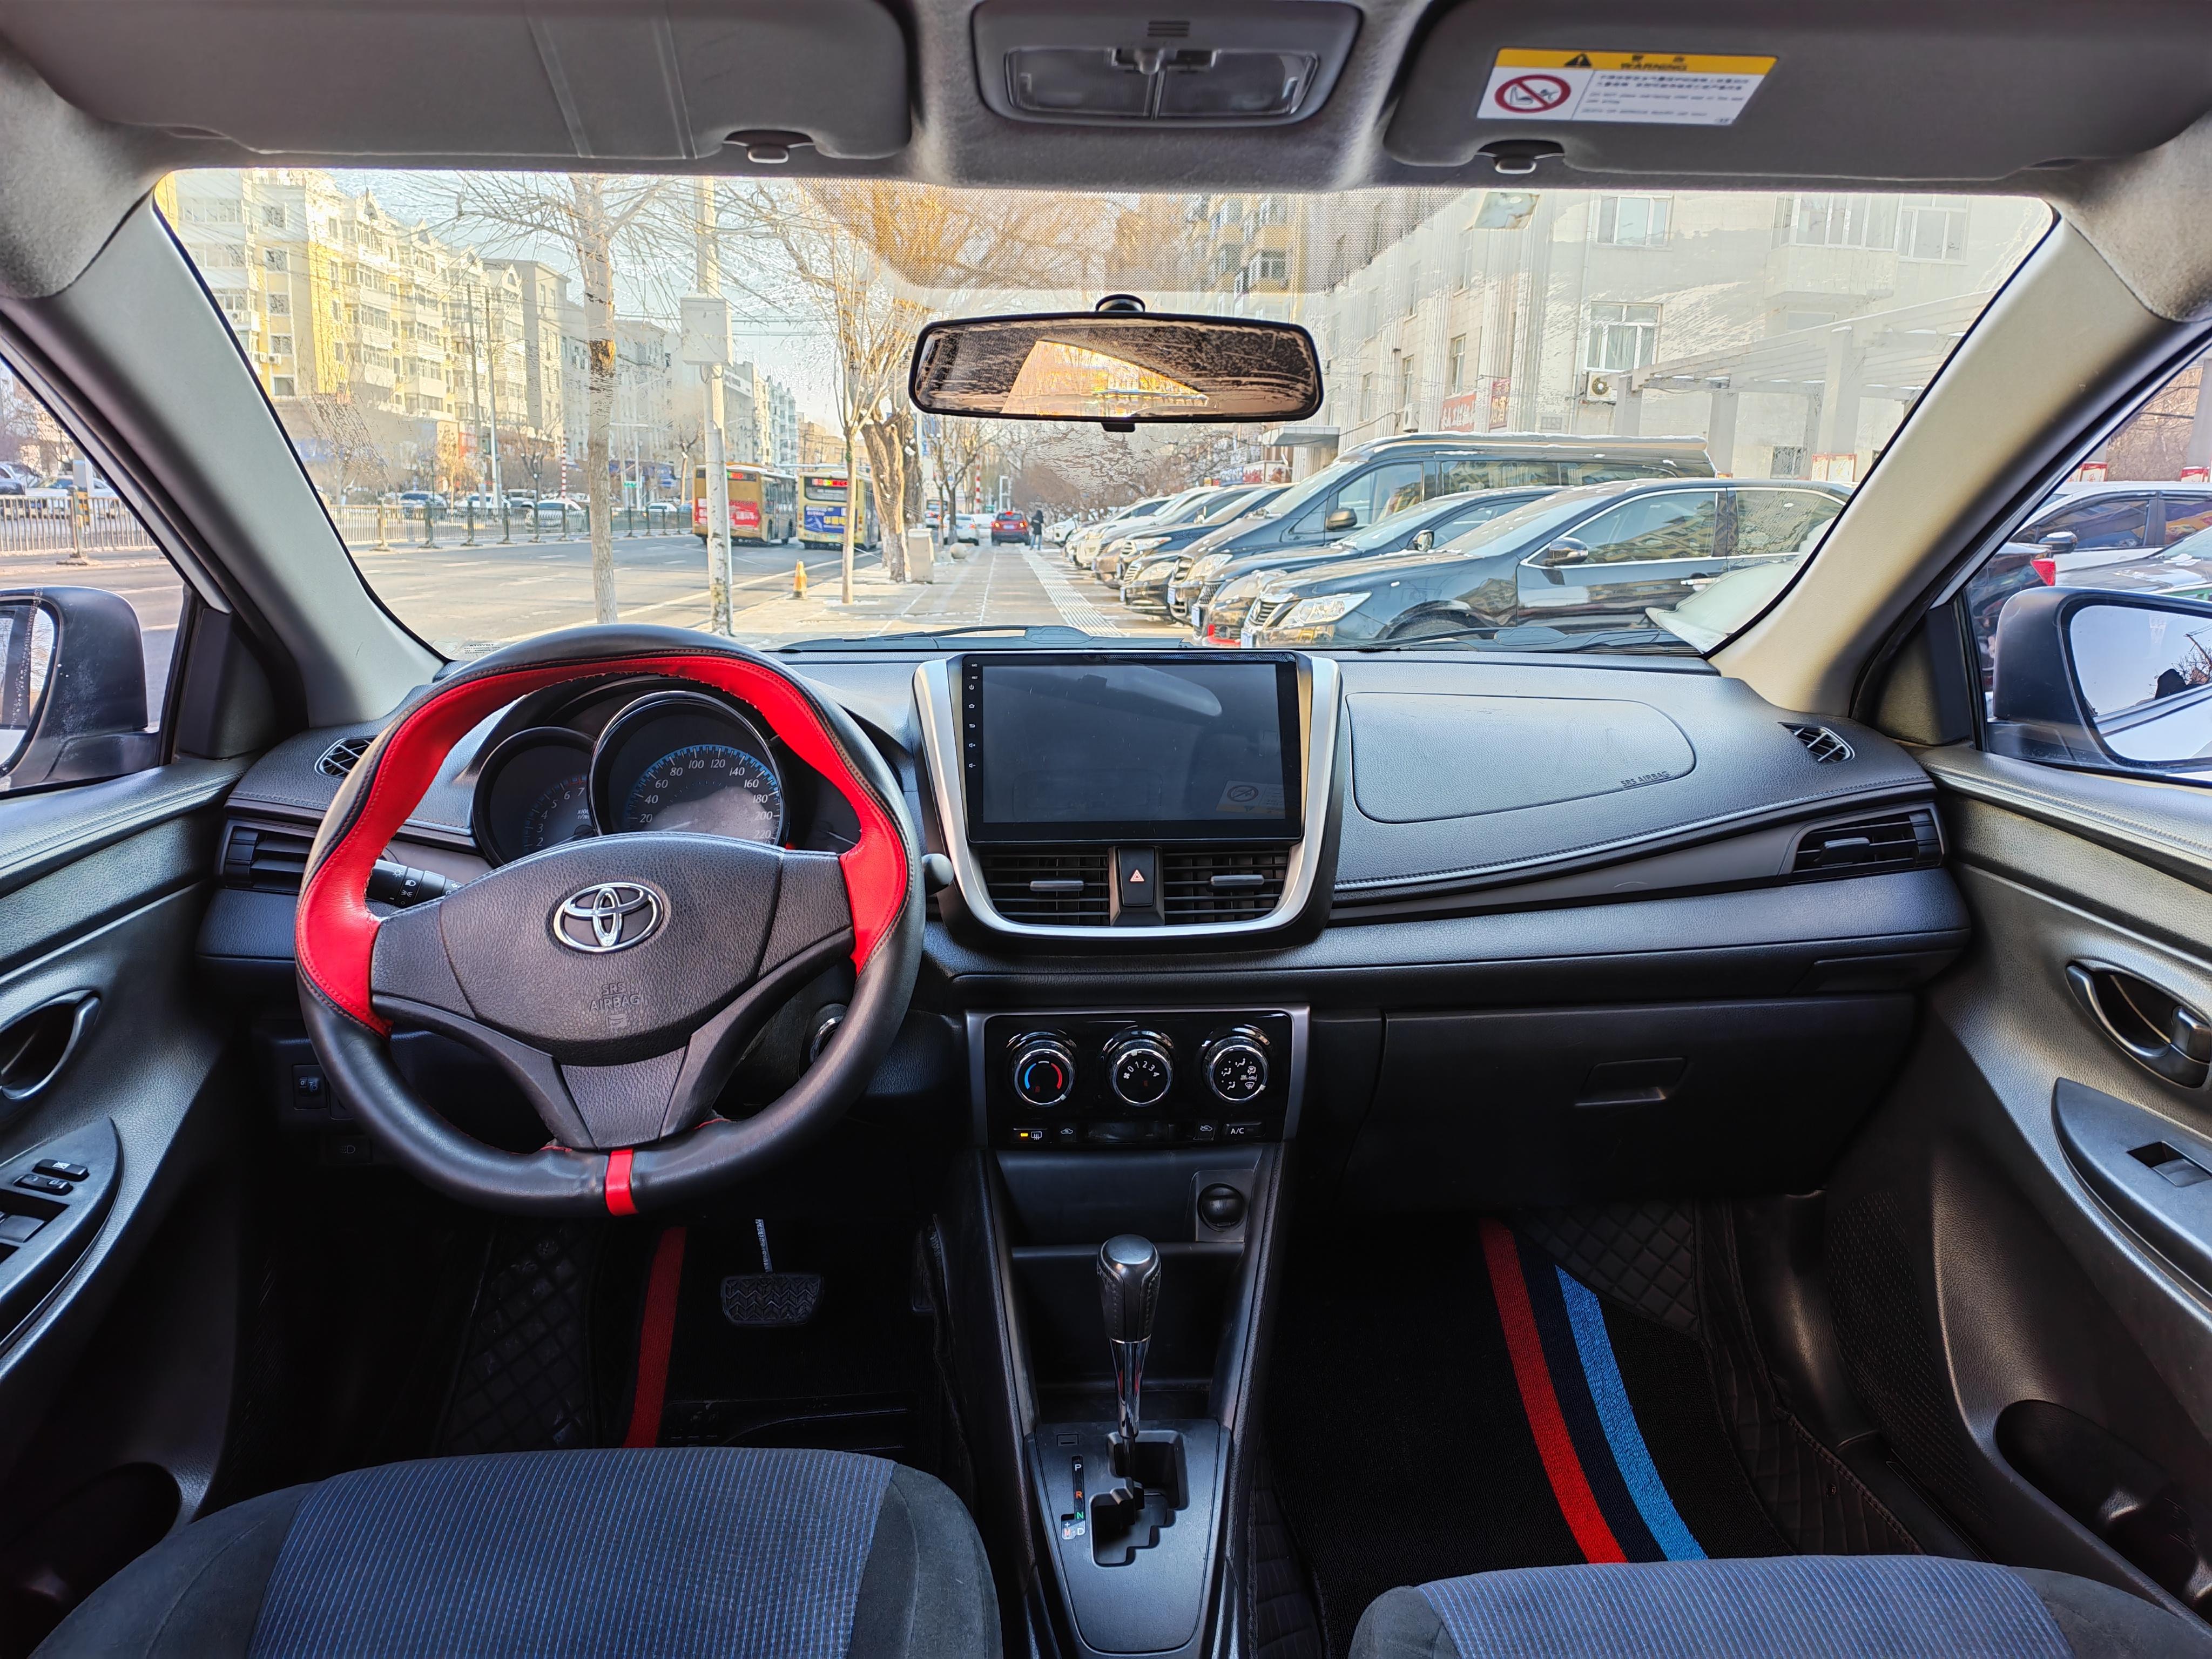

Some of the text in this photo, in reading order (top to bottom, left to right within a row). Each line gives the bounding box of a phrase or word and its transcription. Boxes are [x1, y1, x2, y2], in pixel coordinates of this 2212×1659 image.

[689, 760, 704, 769] 100
[711, 759, 725, 768] 120
[670, 767, 683, 776] 80
[729, 767, 745, 776] 140
[655, 779, 668, 788] 60
[744, 779, 759, 788] 160
[1621, 771, 1670, 787] SRS AIRBAG
[564, 791, 571, 800] 6
[577, 787, 585, 797] 7
[644, 794, 658, 804] 40
[753, 794, 768, 803] 180
[551, 799, 558, 808] 5
[541, 810, 548, 819] 4
[639, 814, 653, 823] 20
[755, 811, 773, 820] 200
[537, 824, 544, 833] 3
[753, 830, 771, 839] 220
[536, 837, 543, 846] 2
[601, 982, 625, 995] SRS
[589, 994, 640, 1012] AIRBAG
[1063, 1528, 1071, 1536] M
